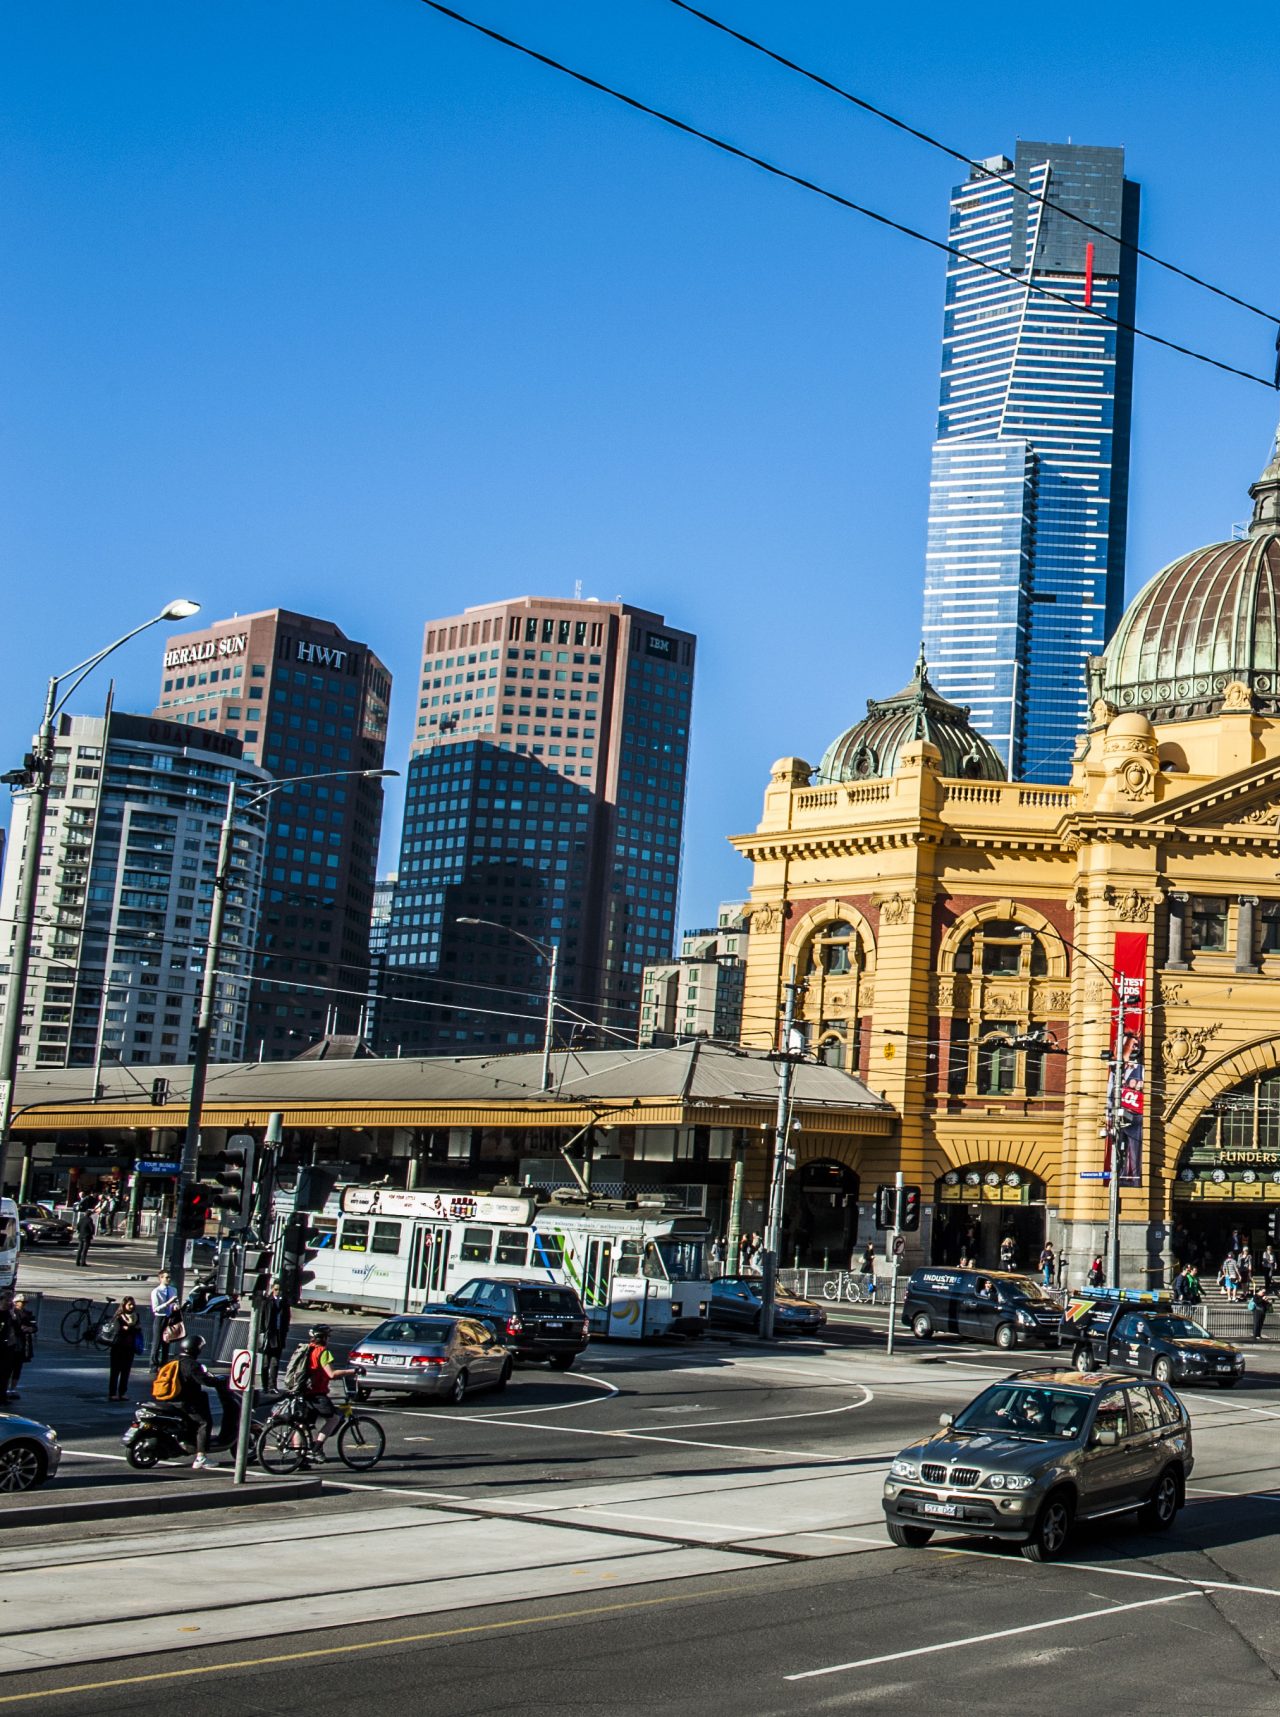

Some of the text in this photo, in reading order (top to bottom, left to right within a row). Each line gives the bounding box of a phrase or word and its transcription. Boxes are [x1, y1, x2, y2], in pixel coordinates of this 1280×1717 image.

[163, 635, 247, 668] HERALD SUN
[649, 636, 670, 652] IBM
[297, 640, 347, 669] HWT
[1114, 977, 1144, 987] LTEST
[1121, 1090, 1140, 1107] OL
[1219, 1150, 1278, 1163] FLINDERS
[923, 1273, 962, 1284] INDUSTRIE
